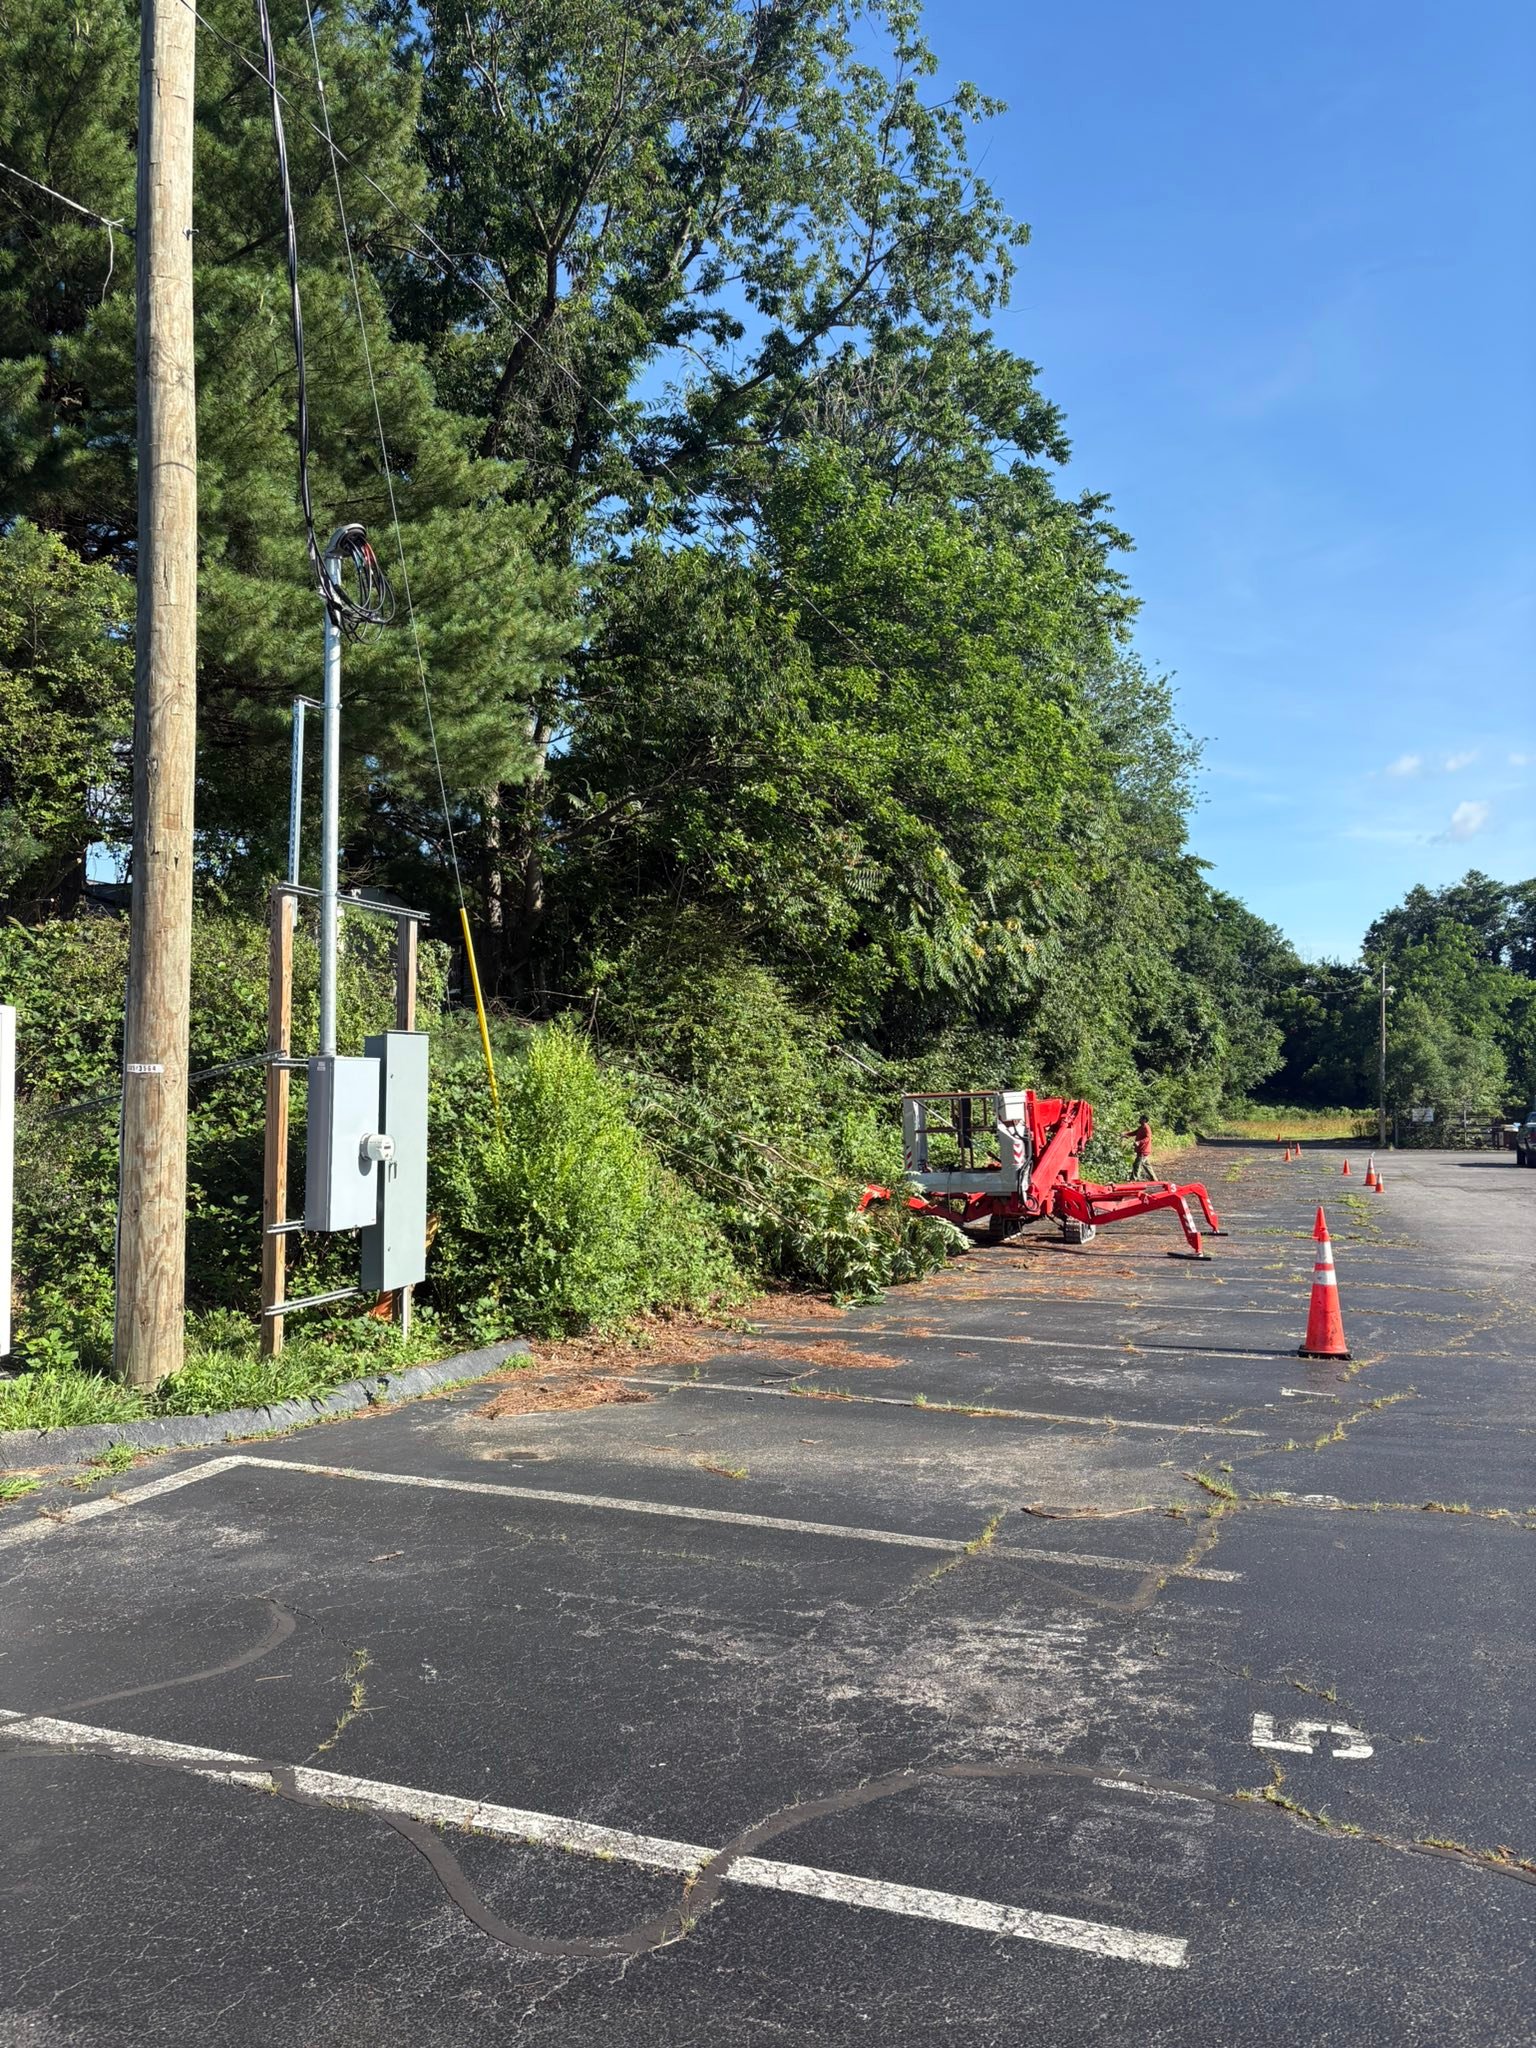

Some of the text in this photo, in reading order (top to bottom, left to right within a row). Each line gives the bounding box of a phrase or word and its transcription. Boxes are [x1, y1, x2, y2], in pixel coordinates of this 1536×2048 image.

[1170, 1183, 1177, 1193] 3
[1143, 1195, 1150, 1204] 4
[1252, 1713, 1374, 1759] 5
